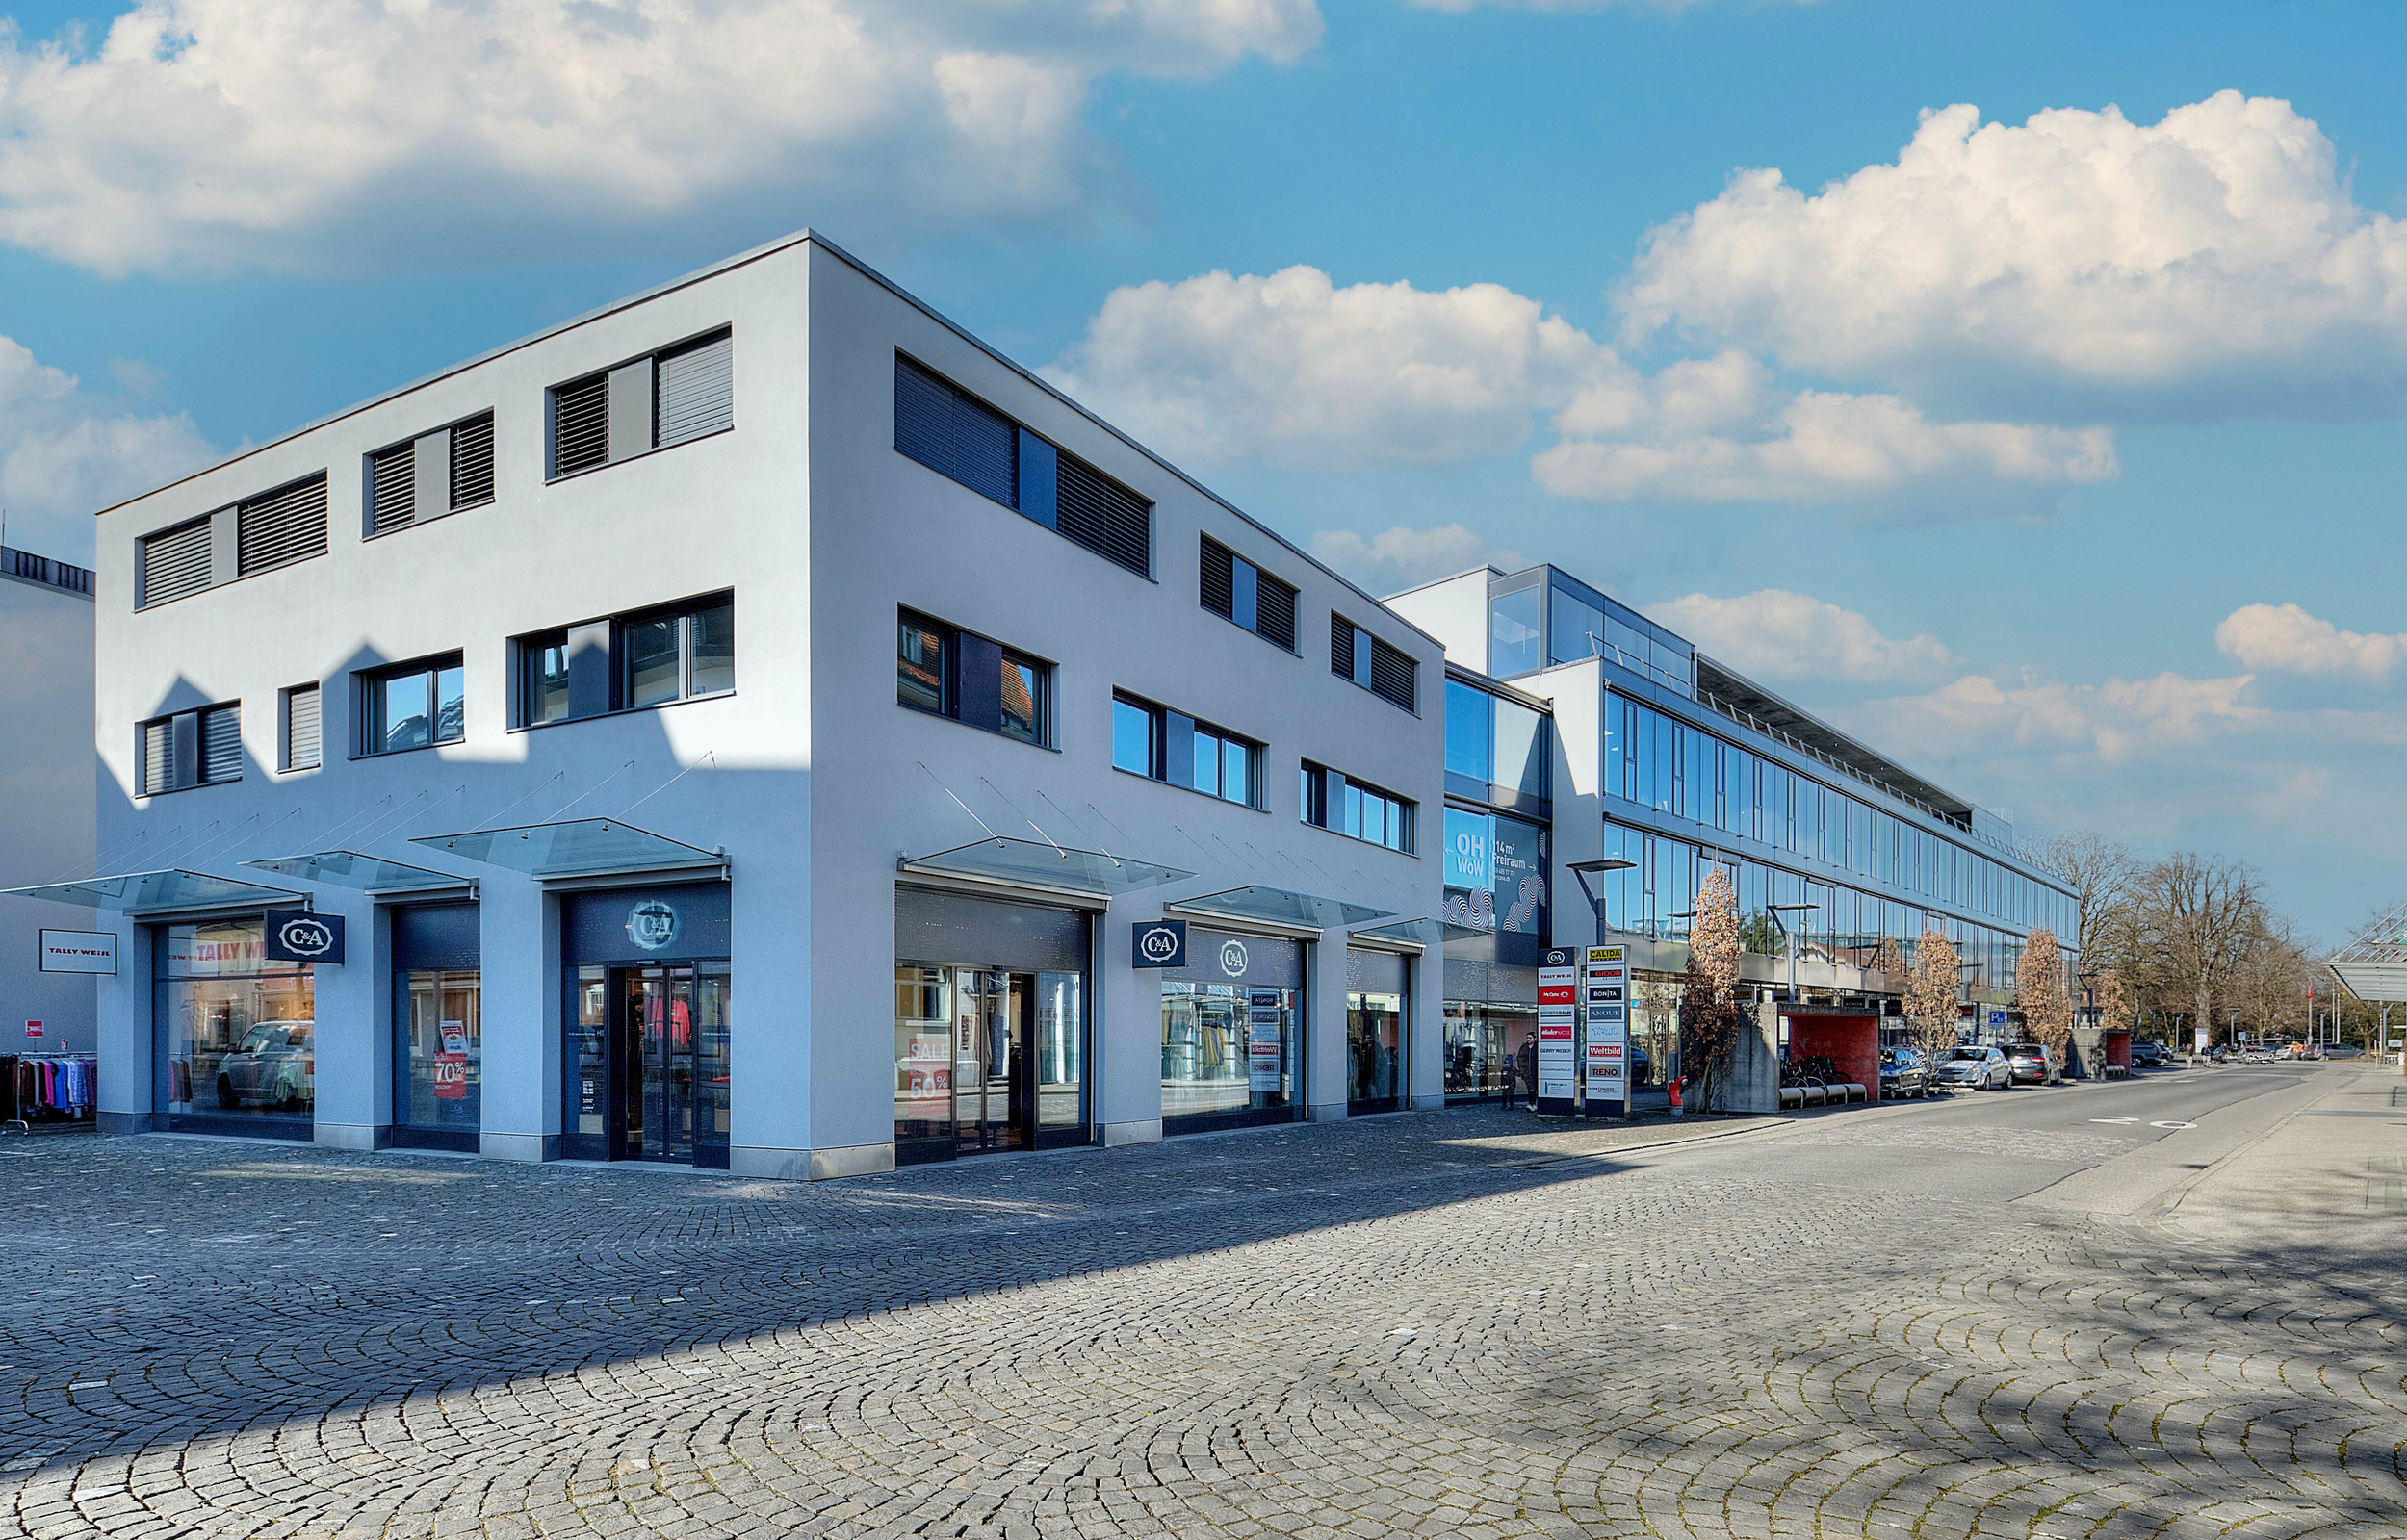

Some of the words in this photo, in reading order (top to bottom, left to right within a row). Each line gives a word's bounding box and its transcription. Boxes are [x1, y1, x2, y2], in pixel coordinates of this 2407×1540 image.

[1456, 833, 1484, 858] OH
[1492, 852, 1526, 869] Freiraum
[640, 914, 672, 936] C&A
[289, 928, 324, 946] C&A
[1147, 937, 1172, 952] C&A
[197, 942, 240, 961] TALLY
[1225, 949, 1244, 967] C&A
[1991, 1013, 1999, 1021] P
[911, 1043, 948, 1060] SALE
[1590, 1046, 1621, 1055] Weltbild
[435, 1062, 464, 1083] 70%
[910, 1076, 948, 1099] 50%
